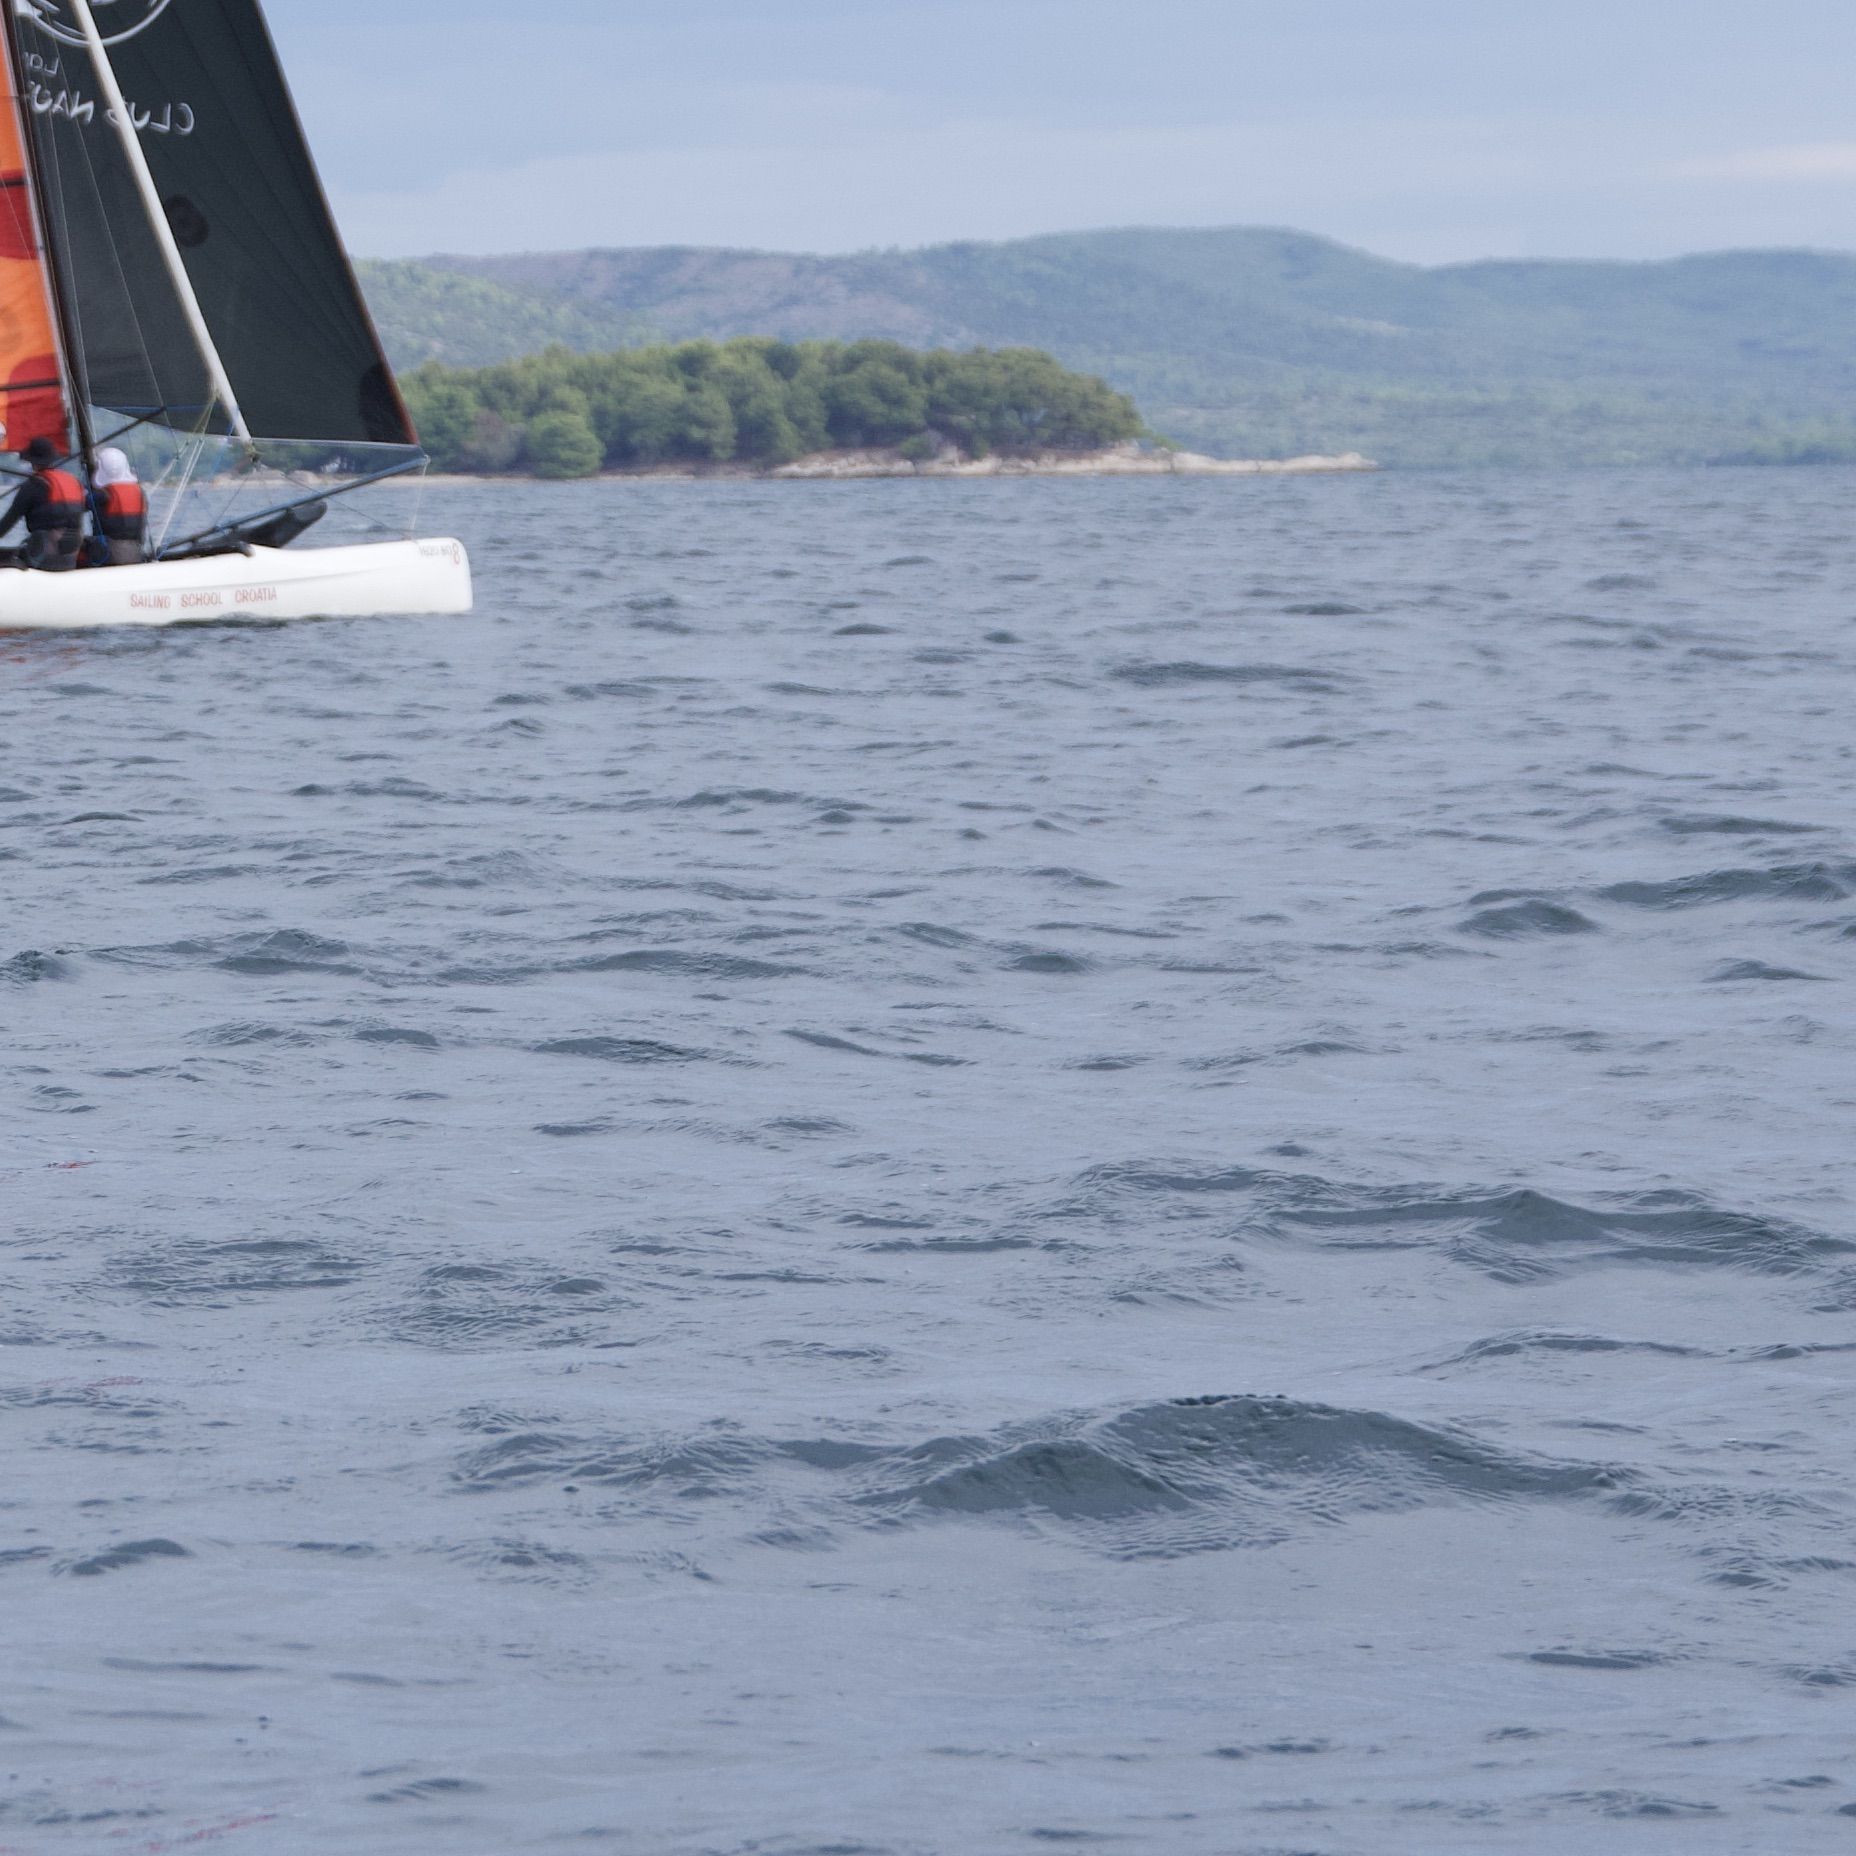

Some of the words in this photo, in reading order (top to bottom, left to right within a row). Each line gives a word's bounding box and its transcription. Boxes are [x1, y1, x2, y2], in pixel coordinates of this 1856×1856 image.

[130, 593, 171, 609] SAILING
[180, 592, 223, 608] SCHOOL
[235, 587, 277, 603] CROATIA
